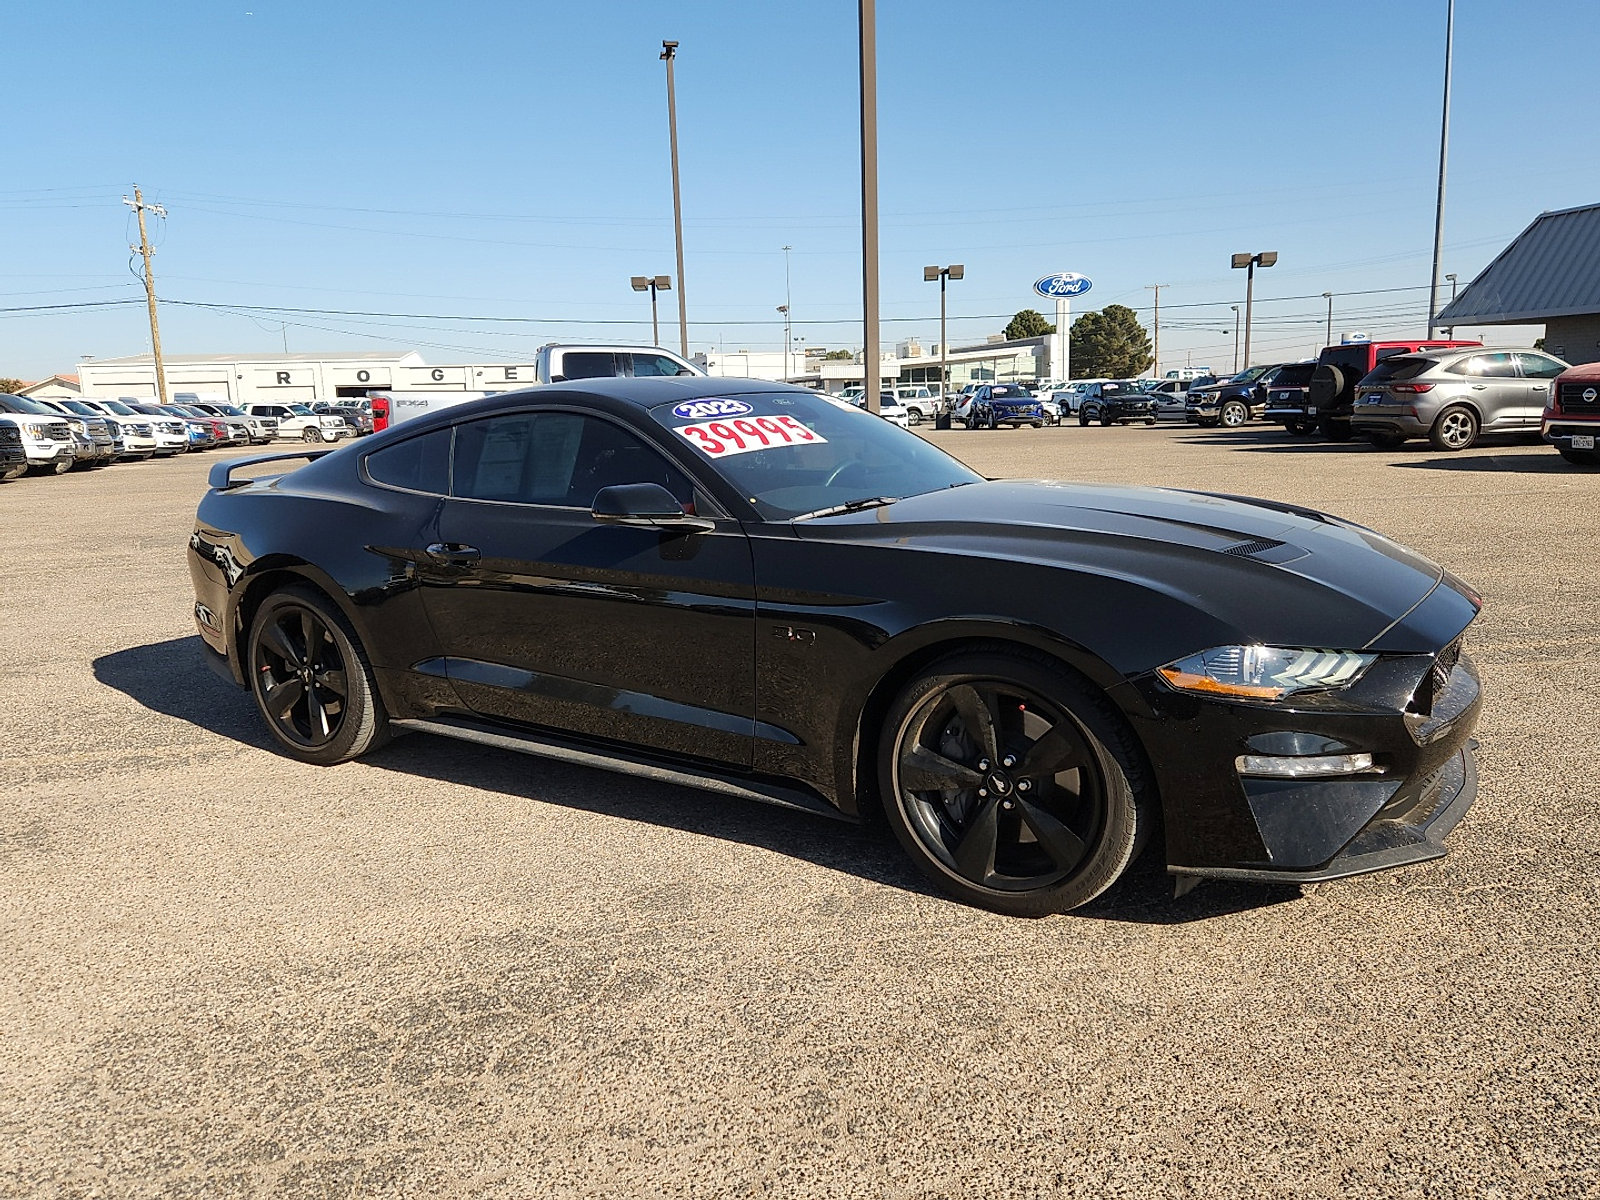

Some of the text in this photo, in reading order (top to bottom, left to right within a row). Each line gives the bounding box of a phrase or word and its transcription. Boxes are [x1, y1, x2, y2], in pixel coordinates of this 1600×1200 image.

[1048, 277, 1083, 294] Ford
[680, 399, 748, 418] 2023
[684, 417, 814, 453] 39995
